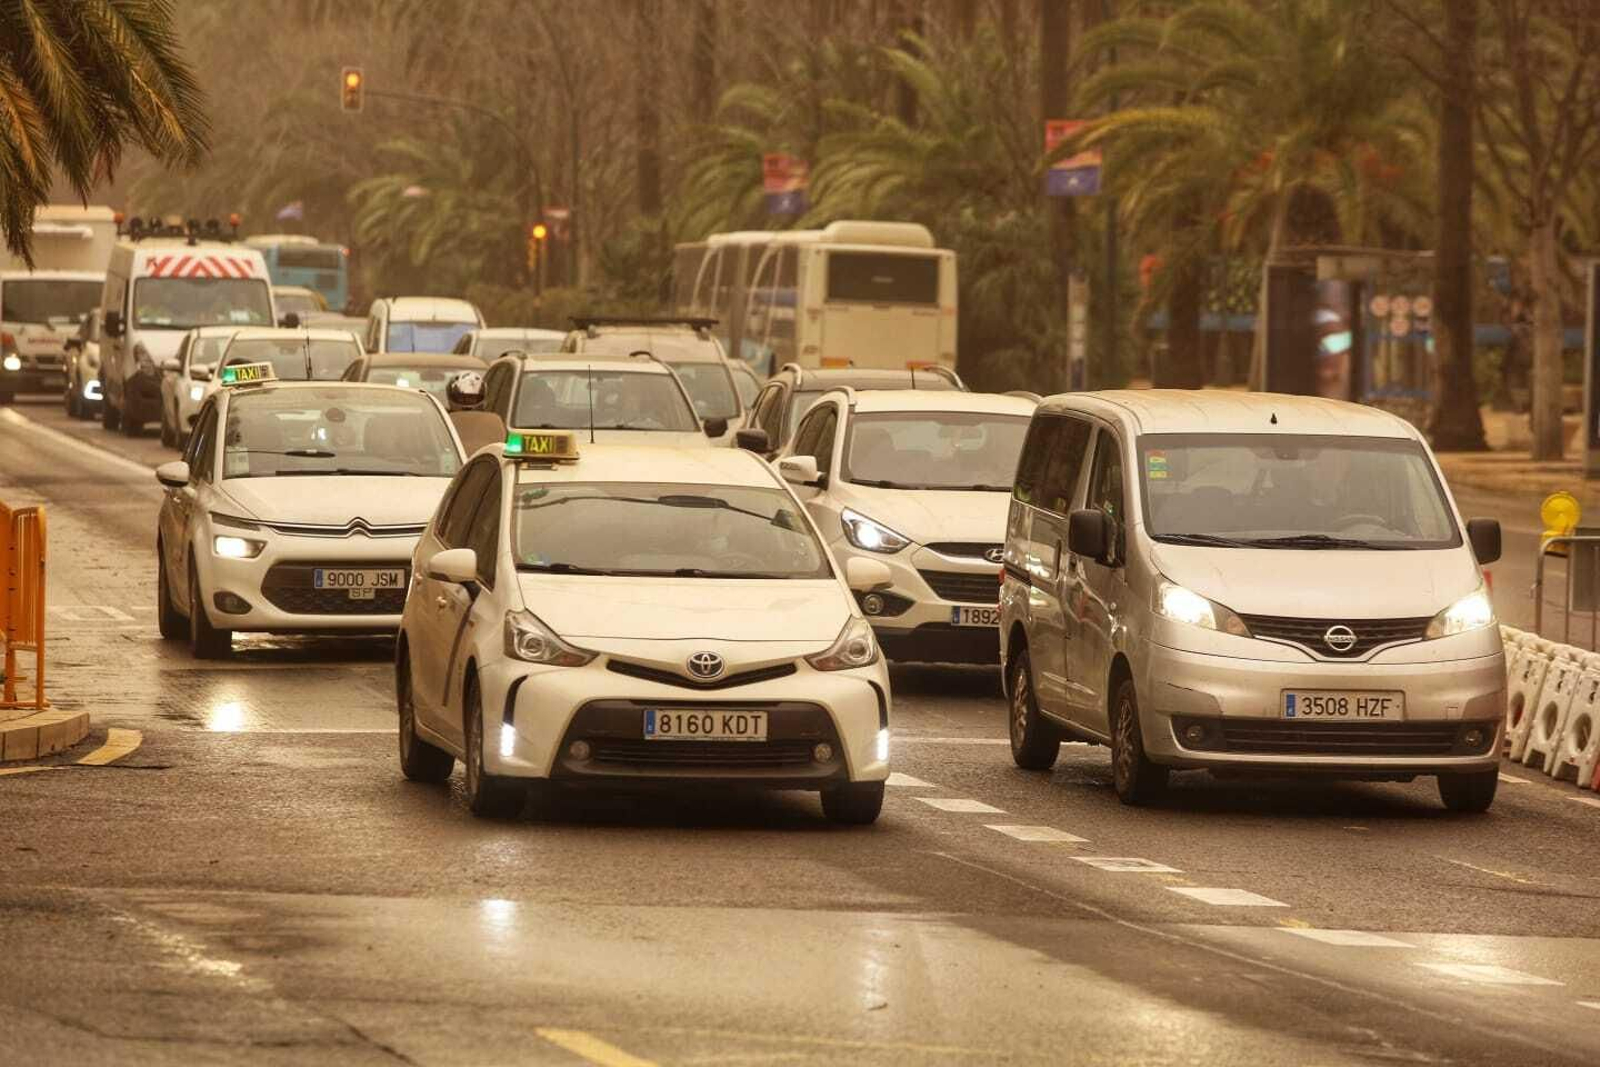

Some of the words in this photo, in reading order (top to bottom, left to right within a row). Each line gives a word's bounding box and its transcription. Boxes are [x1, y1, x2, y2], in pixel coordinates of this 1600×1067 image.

[237, 366, 259, 381] TAXI
[524, 435, 553, 452] TAXI
[328, 572, 364, 586] 9000
[371, 572, 398, 586] JSM
[964, 609, 999, 624] 1892
[1302, 697, 1349, 716] 3508
[1356, 697, 1393, 717] HZF
[659, 714, 714, 734] 8160
[721, 714, 762, 735] KDT
